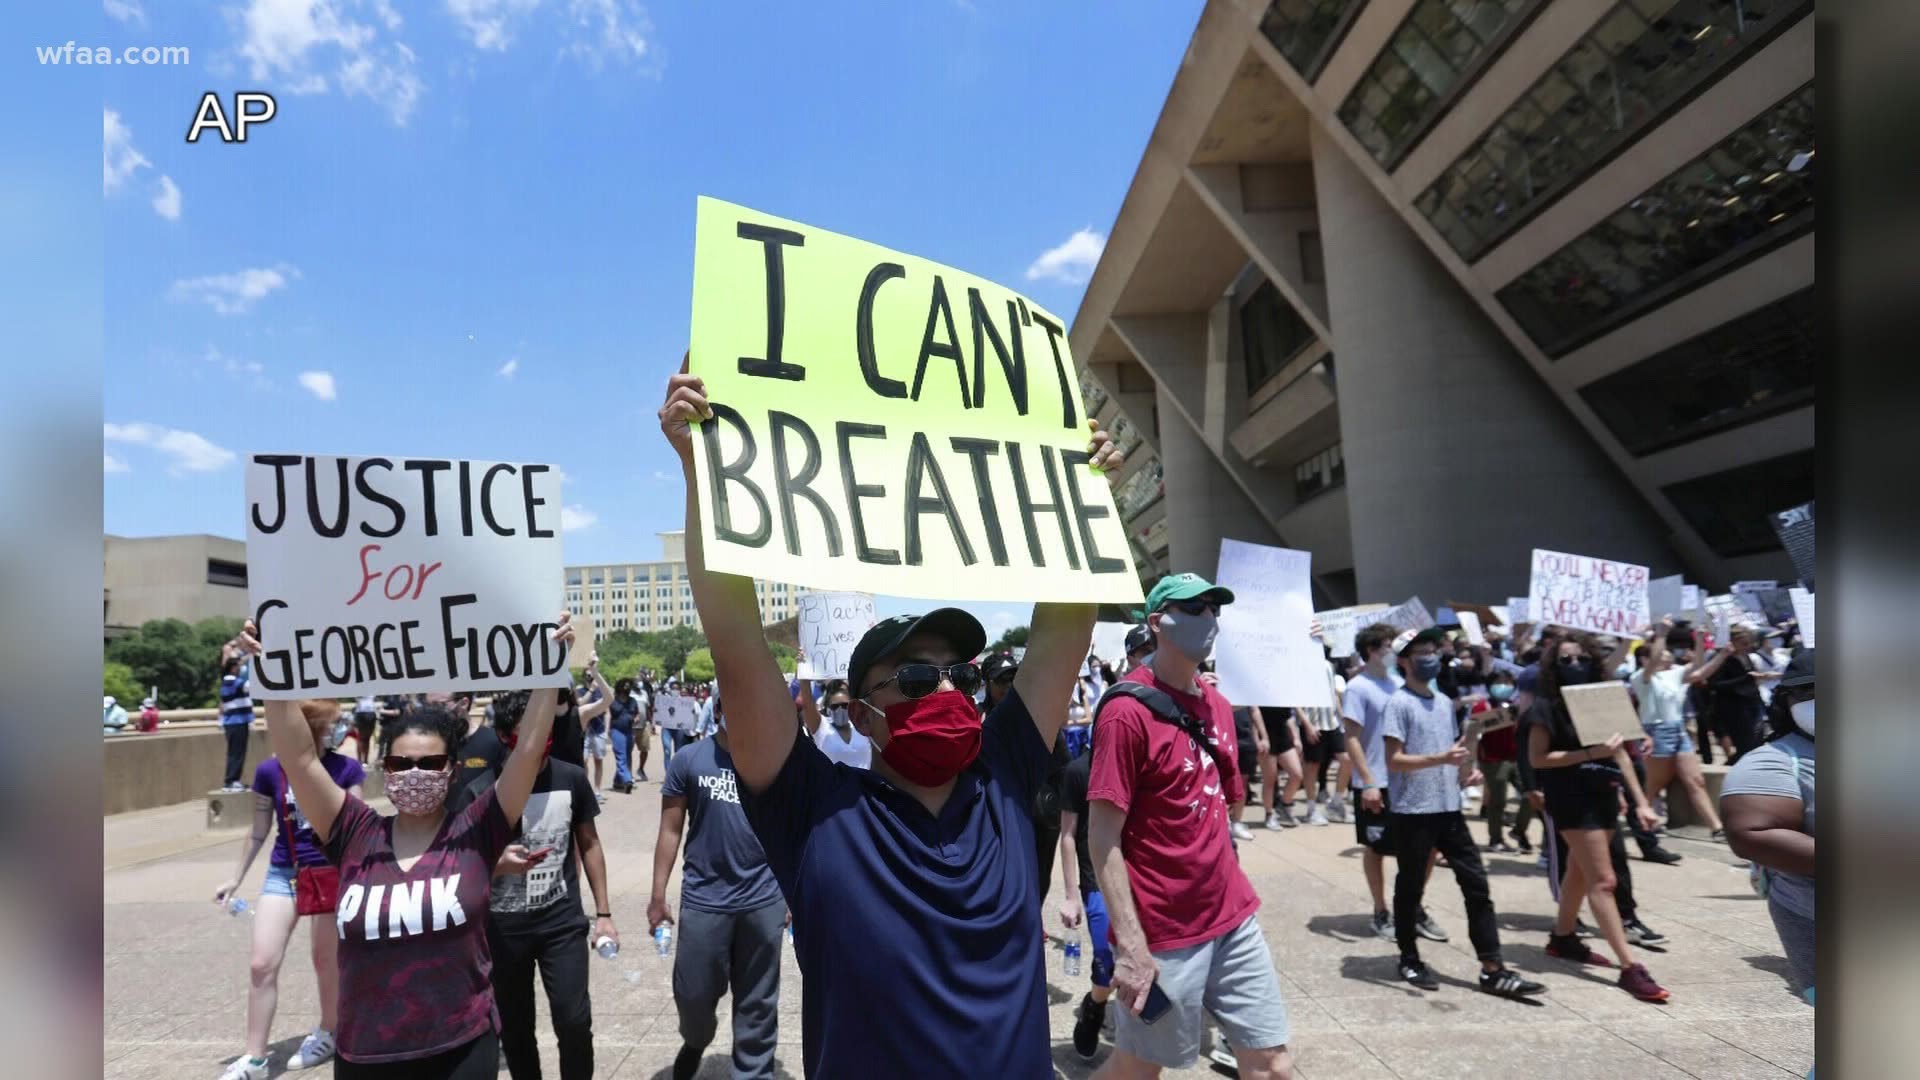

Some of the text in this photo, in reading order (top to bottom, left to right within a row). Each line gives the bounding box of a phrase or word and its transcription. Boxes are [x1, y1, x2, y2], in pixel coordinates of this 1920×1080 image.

[736, 221, 1077, 429] I CAN'T
[252, 455, 555, 538] JUSTICE
[702, 402, 1128, 574] BREATHE
[347, 544, 442, 605] for
[801, 594, 865, 623] Black
[253, 593, 566, 691] GEORGE FLOYD
[815, 625, 856, 647] Lives
[337, 873, 467, 940] PINK
